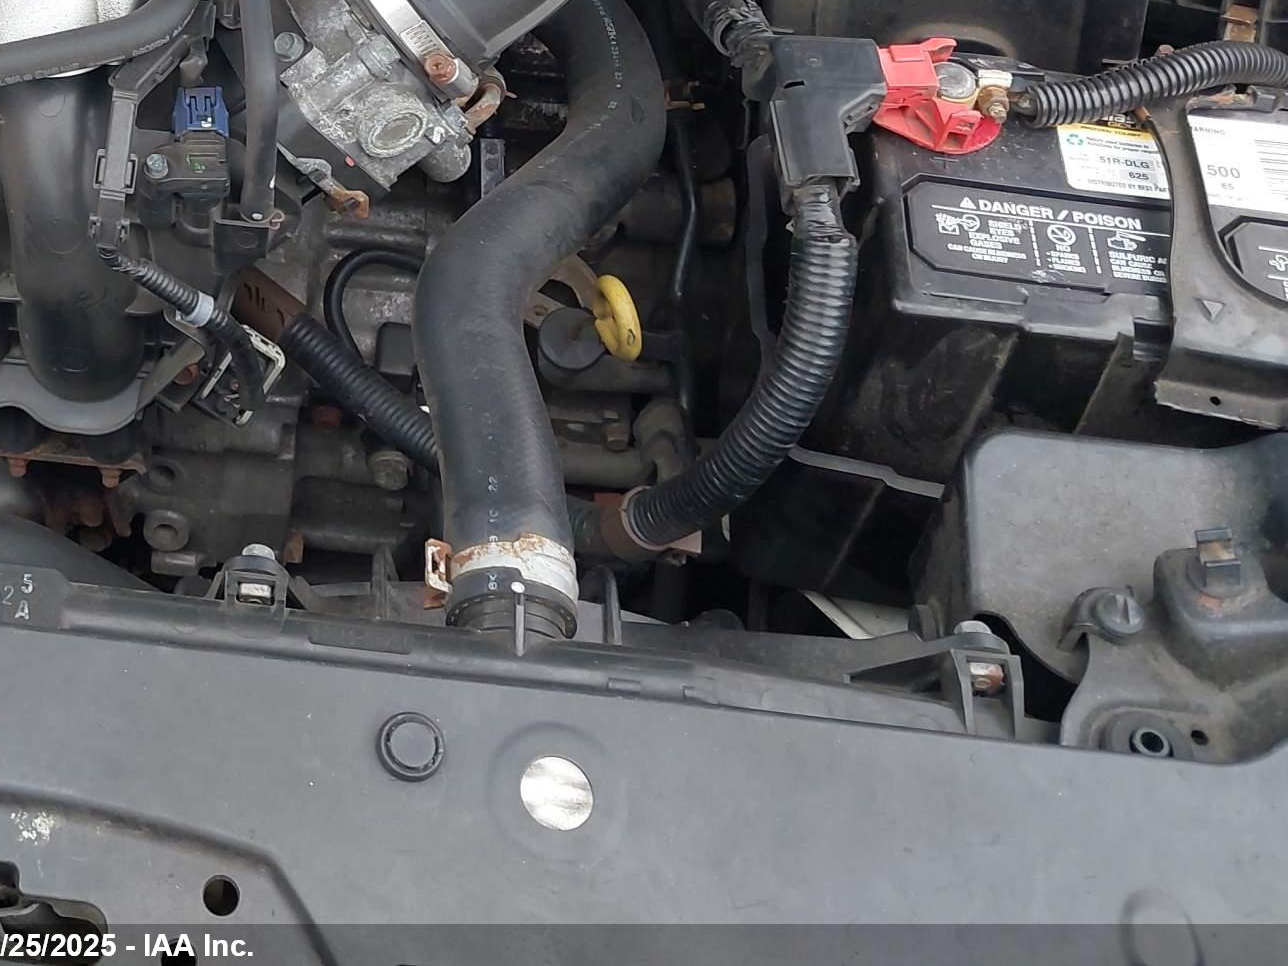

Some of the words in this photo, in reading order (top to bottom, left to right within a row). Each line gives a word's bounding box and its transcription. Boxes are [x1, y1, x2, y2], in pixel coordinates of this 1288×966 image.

[1128, 171, 1149, 181] 625
[1207, 164, 1241, 179] 500
[978, 199, 1054, 220] DANGER
[1071, 211, 1142, 230] POISON
[14, 599, 31, 620] A
